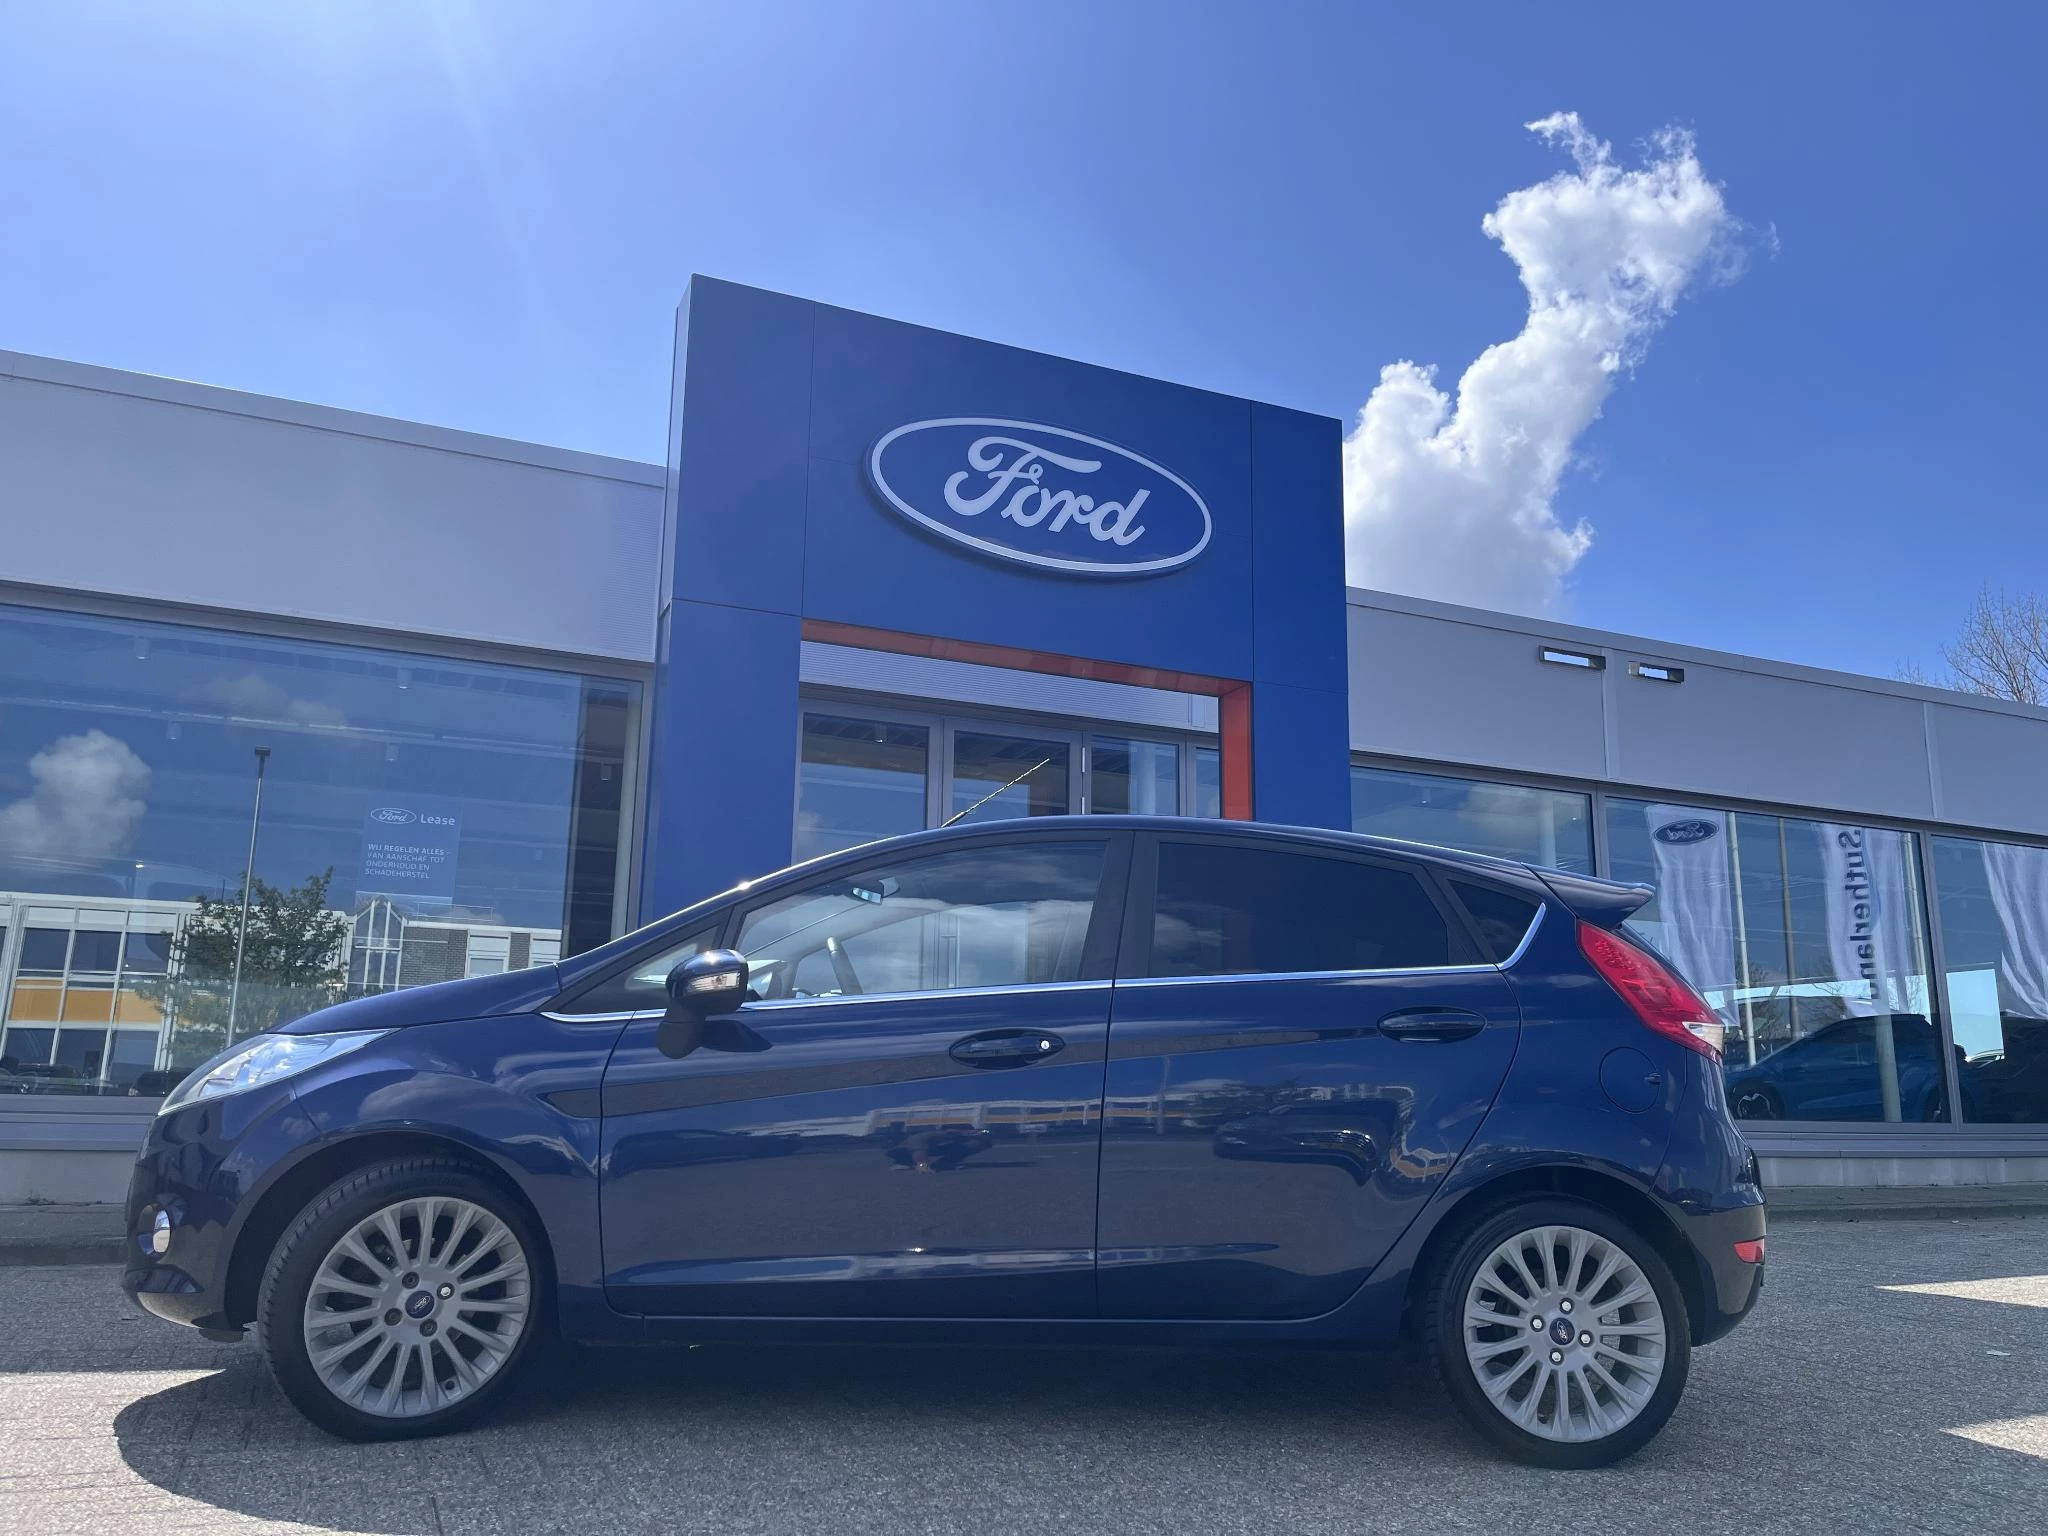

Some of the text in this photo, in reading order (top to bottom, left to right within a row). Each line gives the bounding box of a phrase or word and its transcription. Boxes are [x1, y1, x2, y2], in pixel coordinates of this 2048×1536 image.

[944, 436, 1150, 546] Ford
[378, 809, 456, 826] Ford Lease
[384, 845, 419, 854] REGELEN
[386, 853, 428, 862] AANSCHAF
[366, 860, 430, 871] ONDERHOUD EN
